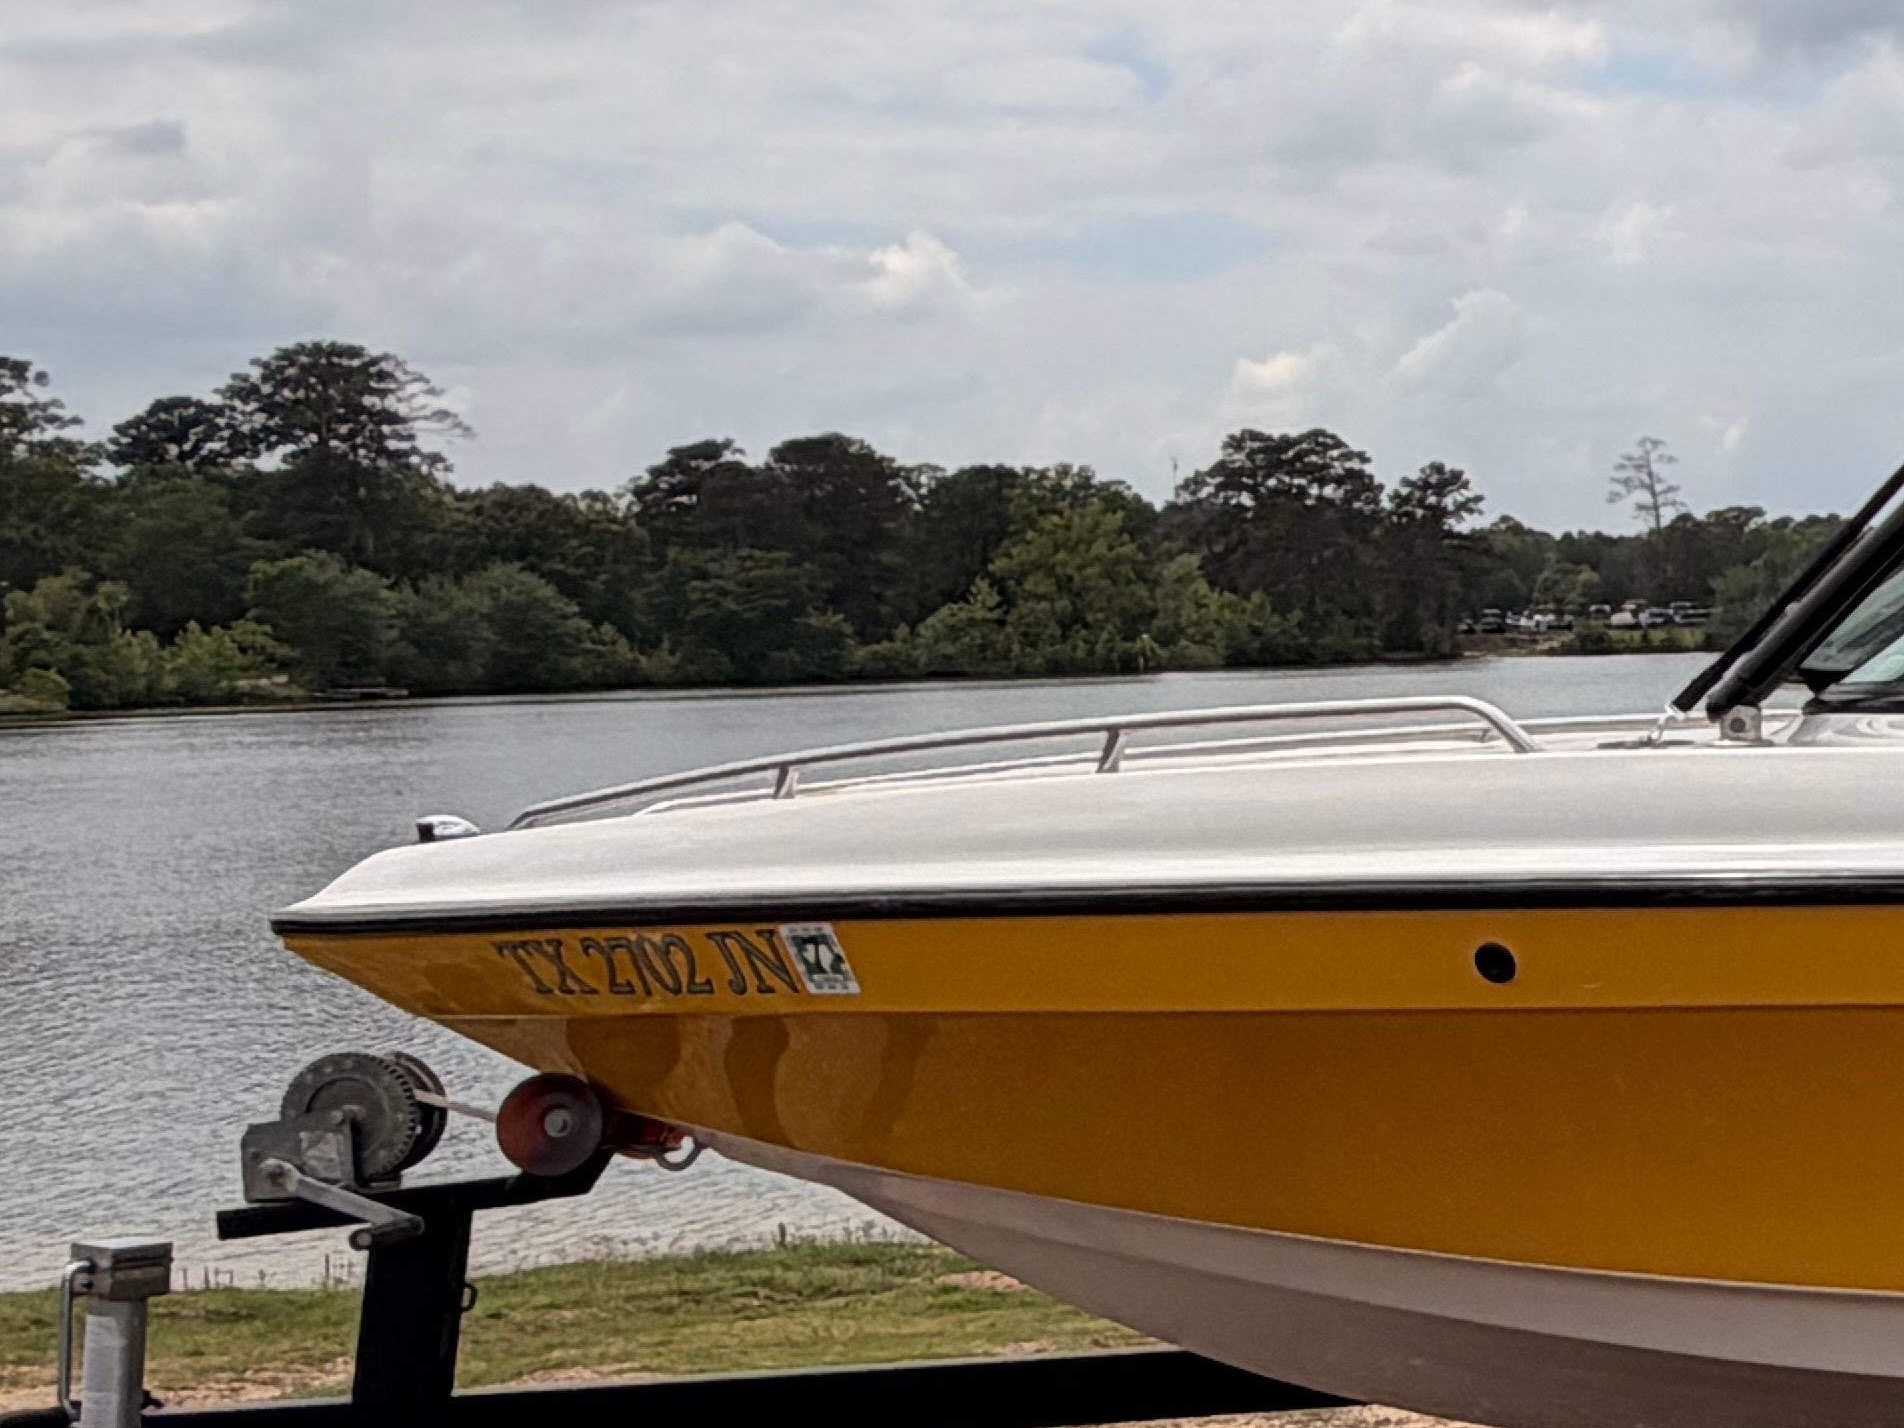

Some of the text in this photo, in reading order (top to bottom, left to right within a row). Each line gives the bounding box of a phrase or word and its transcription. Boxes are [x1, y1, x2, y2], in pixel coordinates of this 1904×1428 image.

[490, 938, 600, 995] TX
[579, 933, 714, 996] 2702
[705, 928, 801, 996] JN
